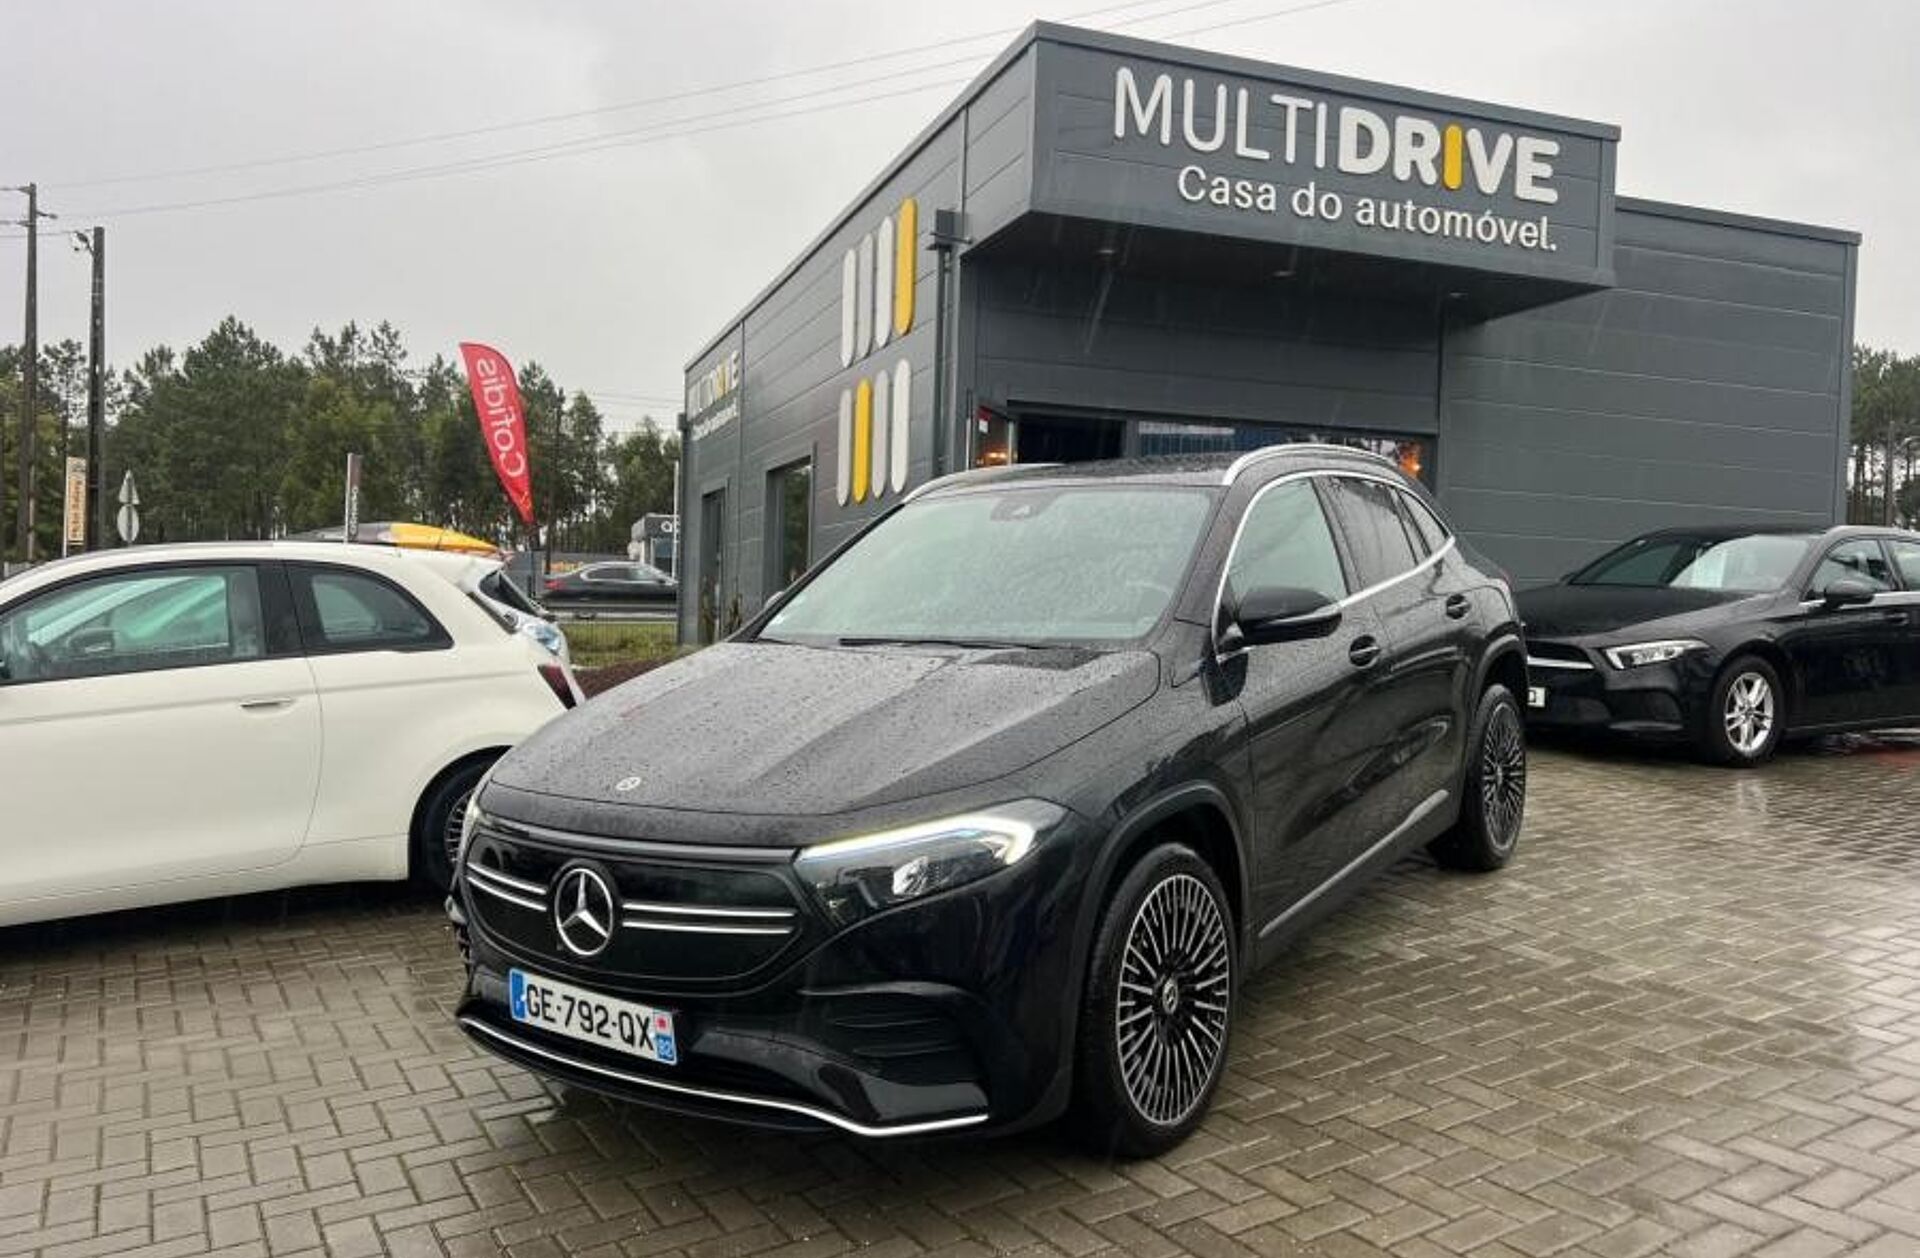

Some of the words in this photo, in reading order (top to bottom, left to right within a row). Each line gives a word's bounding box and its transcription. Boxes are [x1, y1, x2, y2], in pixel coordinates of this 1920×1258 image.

[1113, 66, 1560, 204] MULTIDRIVE
[1178, 165, 1276, 211] Casa
[1292, 182, 1342, 220] do
[1355, 199, 1557, 251] automóvel.
[526, 984, 654, 1051] GE-792-QX
